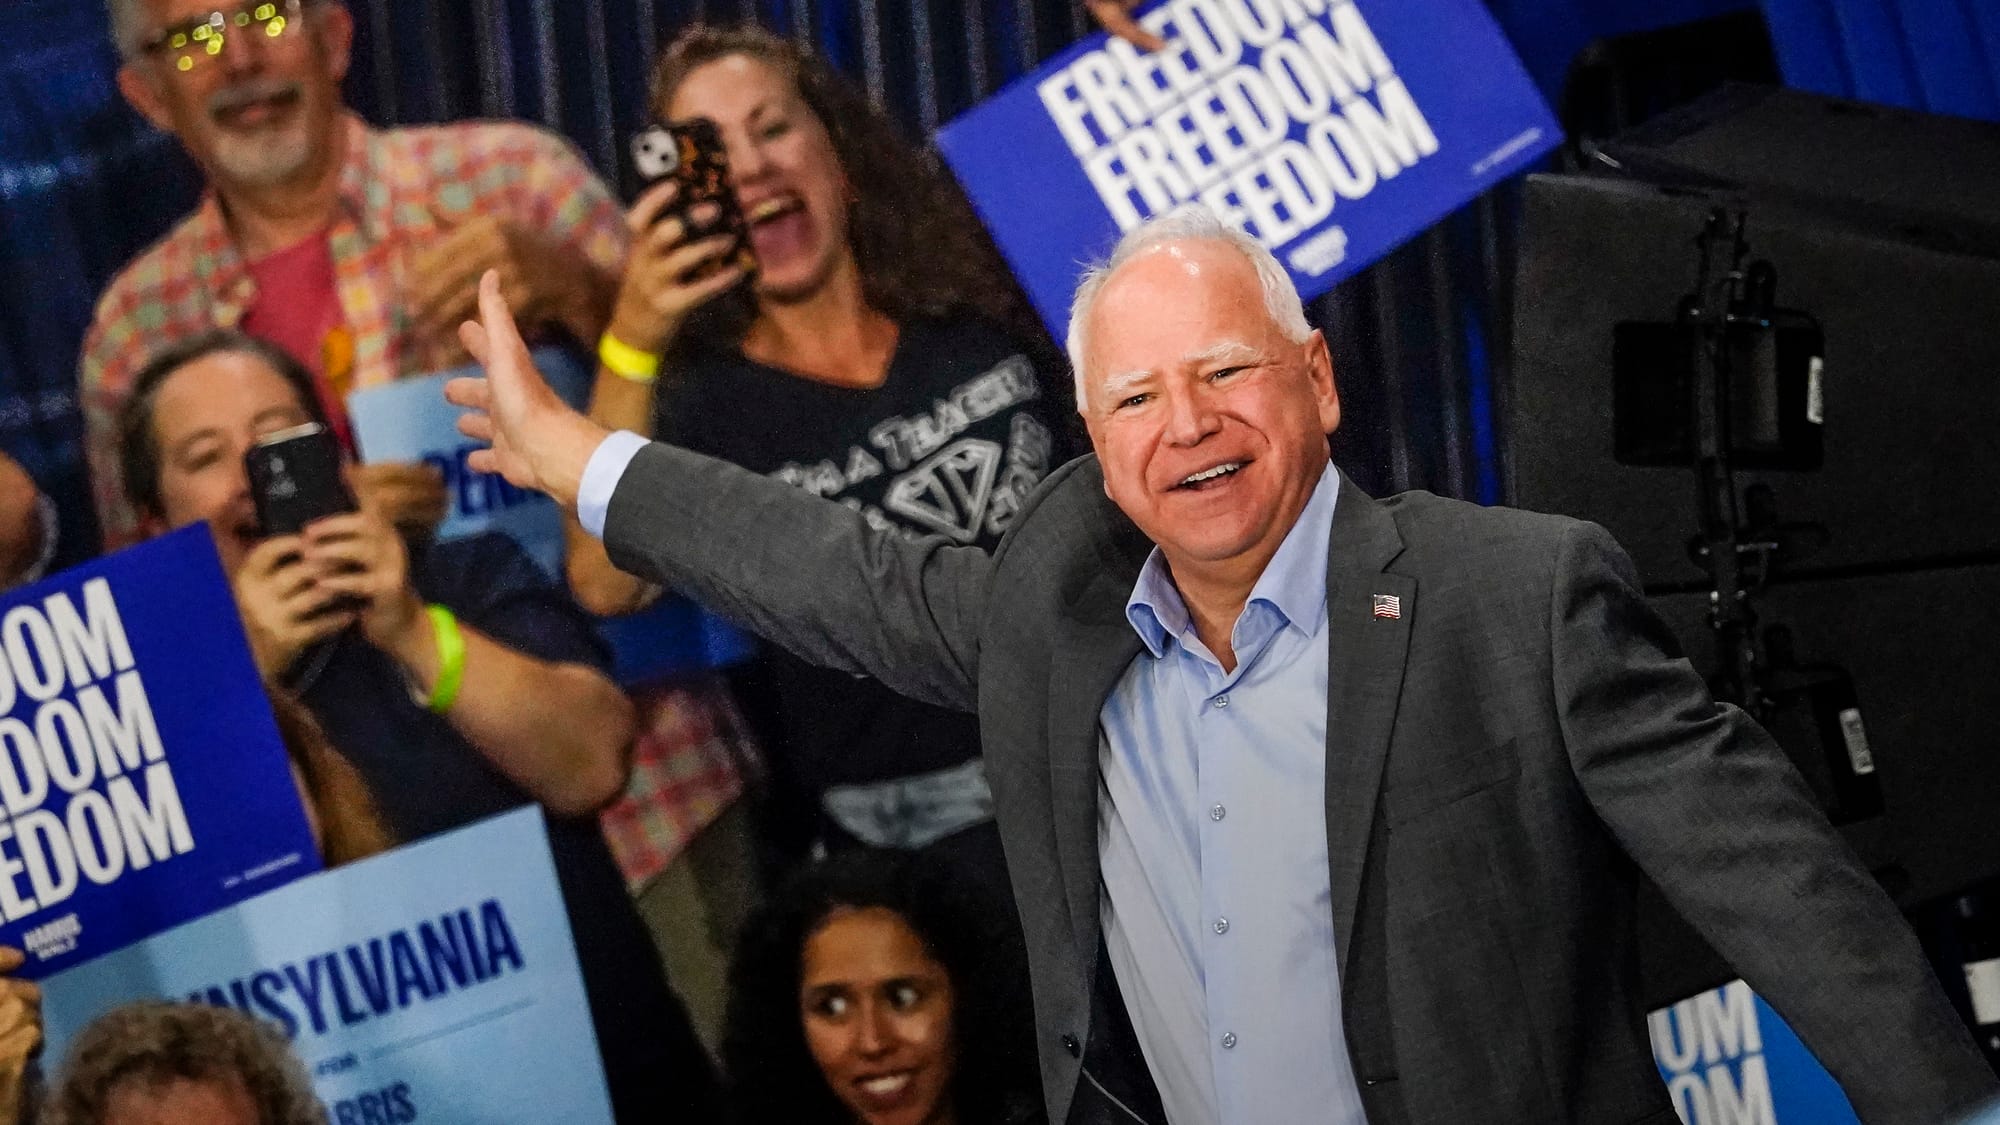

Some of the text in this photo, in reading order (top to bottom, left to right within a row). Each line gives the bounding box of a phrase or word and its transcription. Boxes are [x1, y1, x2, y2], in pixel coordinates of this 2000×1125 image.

[1082, 2, 1396, 233] FREEDOM
[1199, 76, 1439, 250] EEDOM
[0, 576, 135, 716] OM
[0, 669, 165, 822] DOM
[0, 760, 196, 924] EDOM
[187, 898, 525, 1038] NSYLVANIA
[335, 1080, 417, 1125] RRIS
